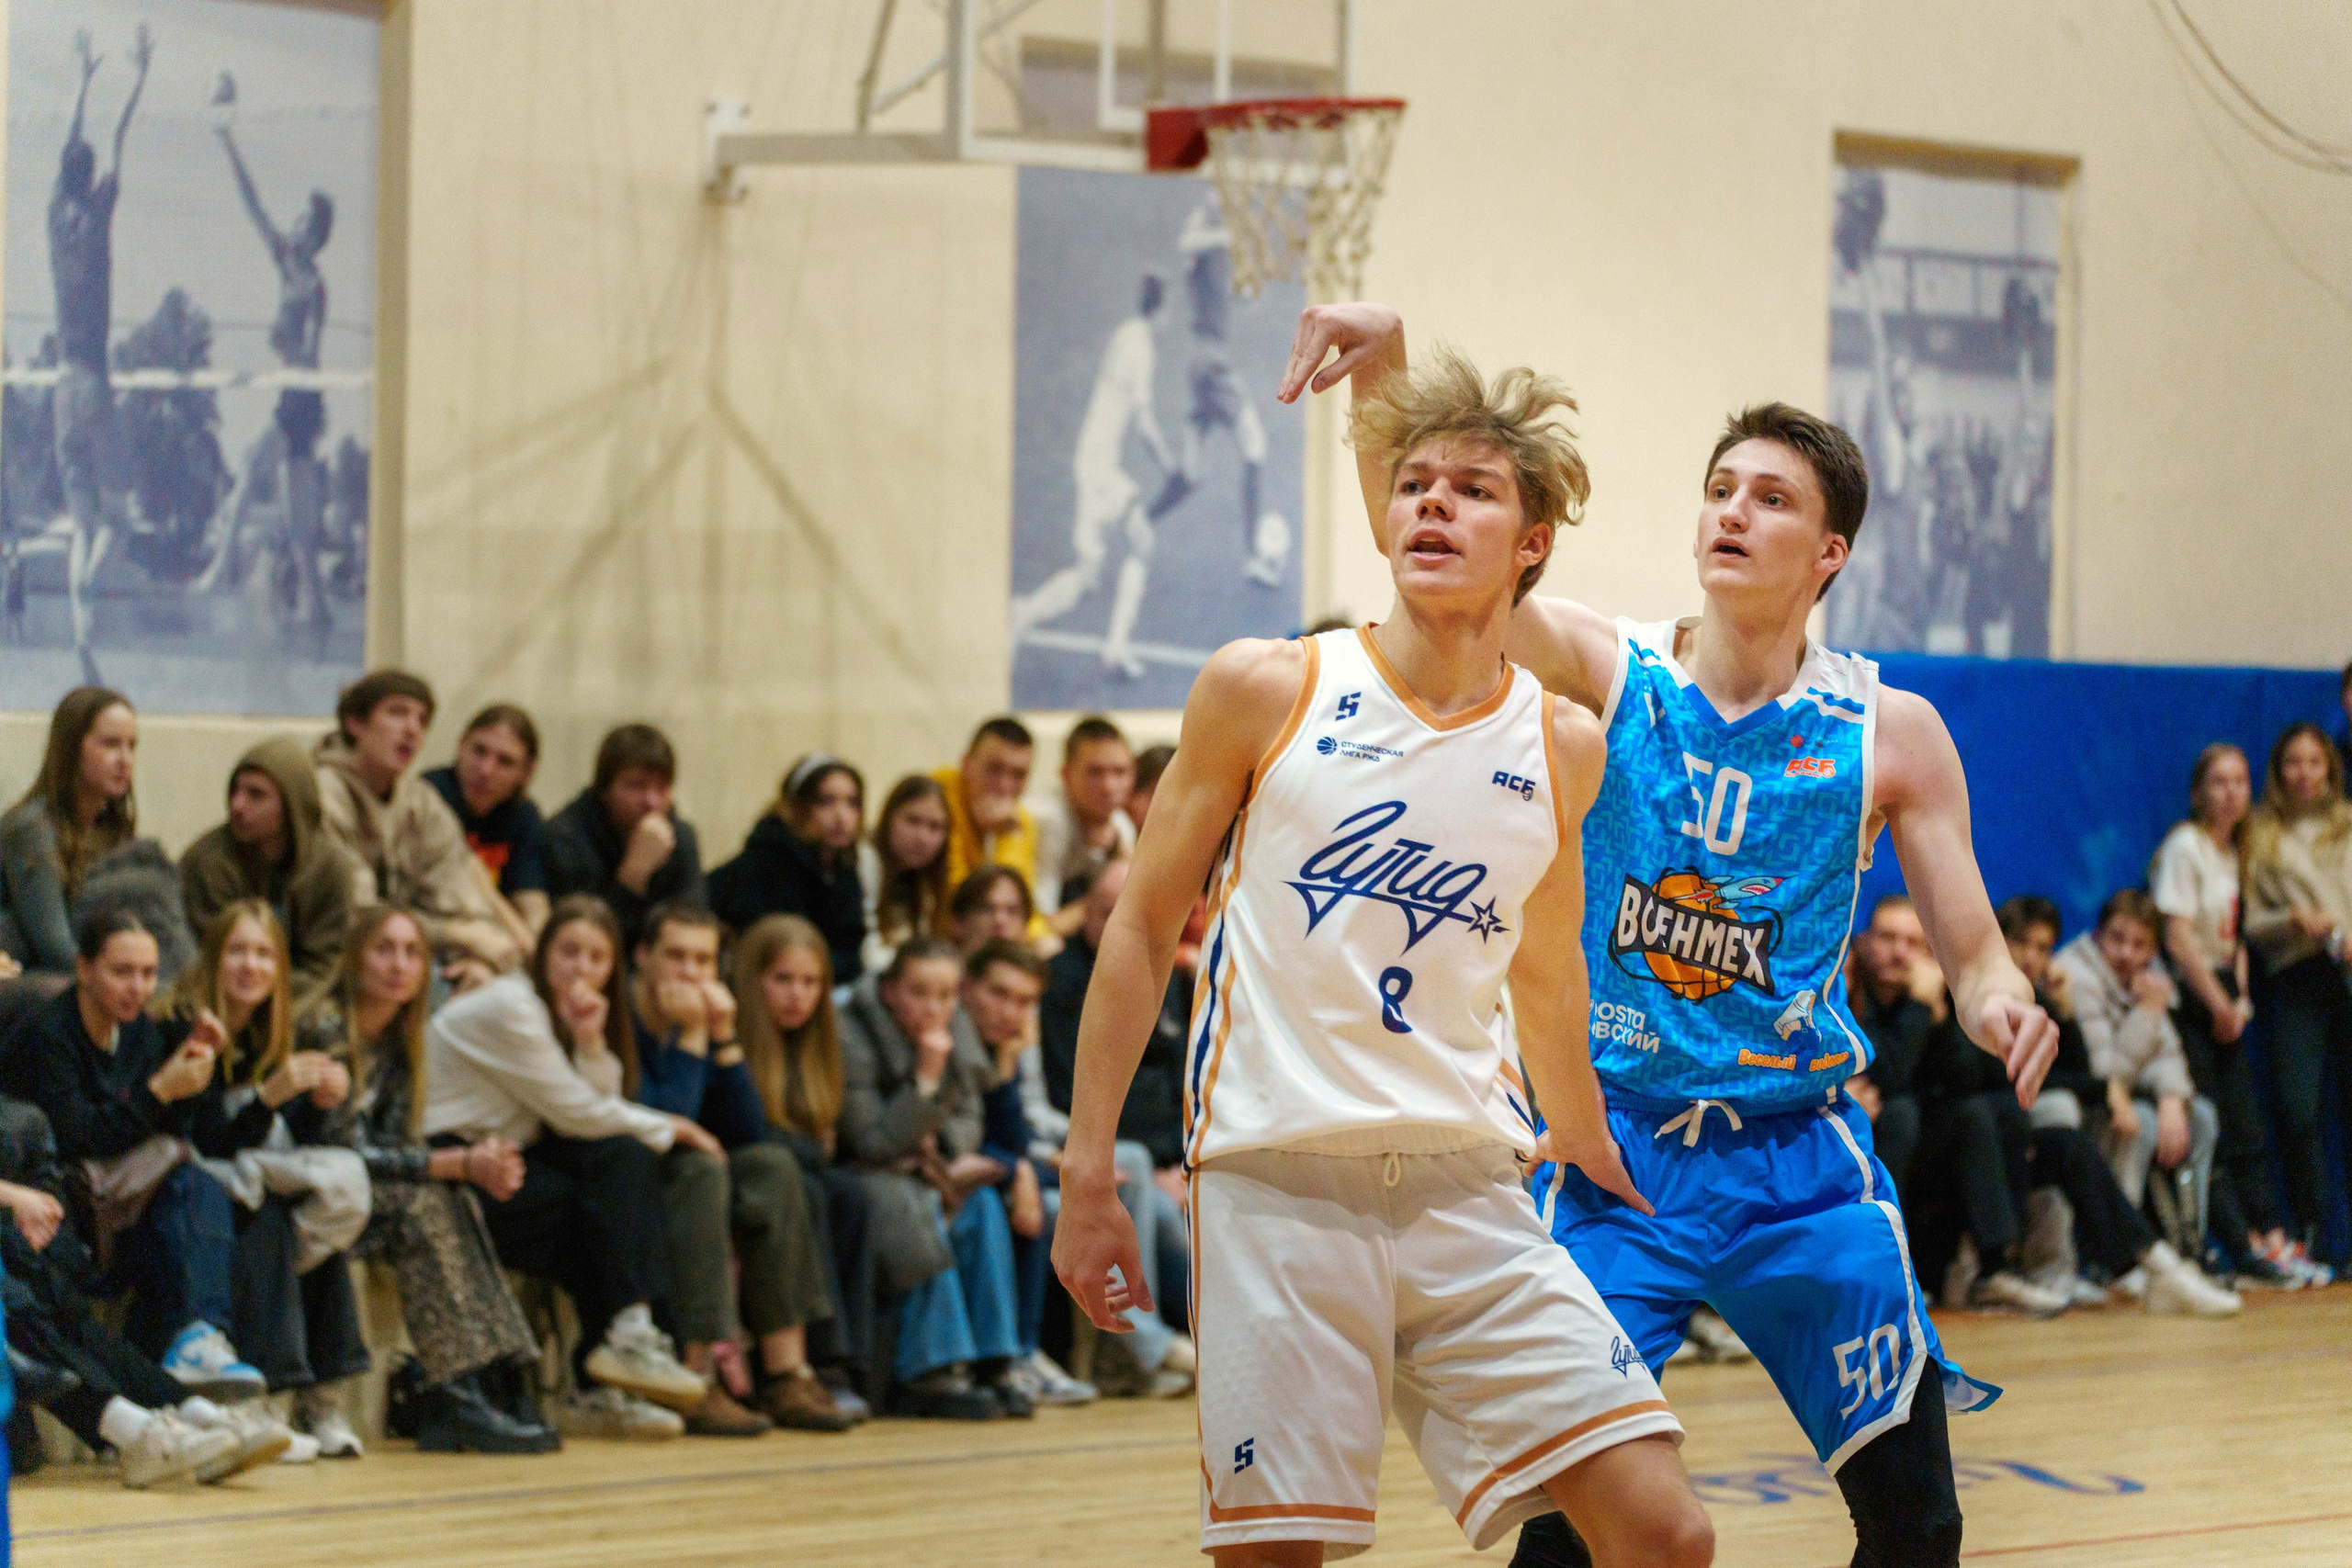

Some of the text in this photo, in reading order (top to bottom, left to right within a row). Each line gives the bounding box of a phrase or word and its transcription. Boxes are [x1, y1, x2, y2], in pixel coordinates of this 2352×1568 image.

[1679, 750, 1753, 856] 50
[1618, 883, 1767, 987] ВОЕНМЕХ
[1379, 966, 1413, 1033] 8
[1833, 1324, 1901, 1420] 50
